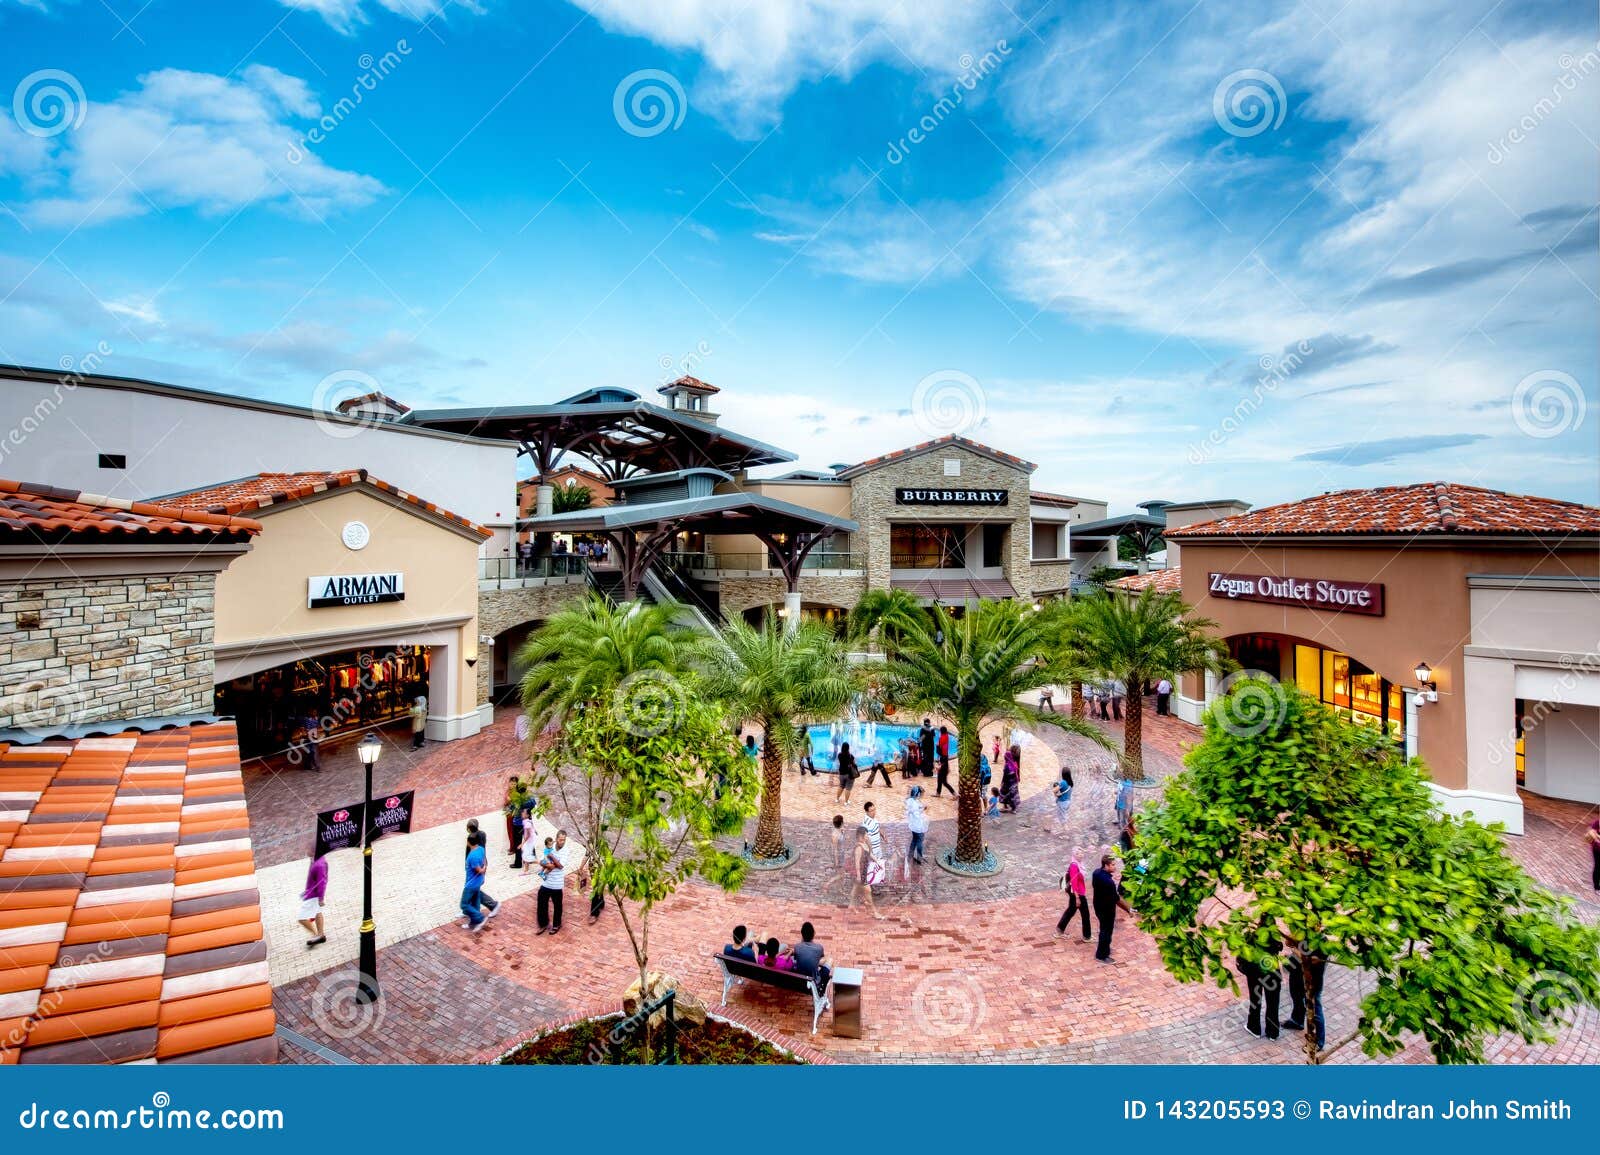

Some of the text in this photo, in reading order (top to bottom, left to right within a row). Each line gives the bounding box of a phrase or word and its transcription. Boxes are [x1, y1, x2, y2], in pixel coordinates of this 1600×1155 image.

[902, 490, 1003, 502] BURBERRY
[322, 575, 397, 597] ARMANI
[1210, 573, 1370, 606] Zegna Outlet Store
[344, 595, 379, 605] OUTLET
